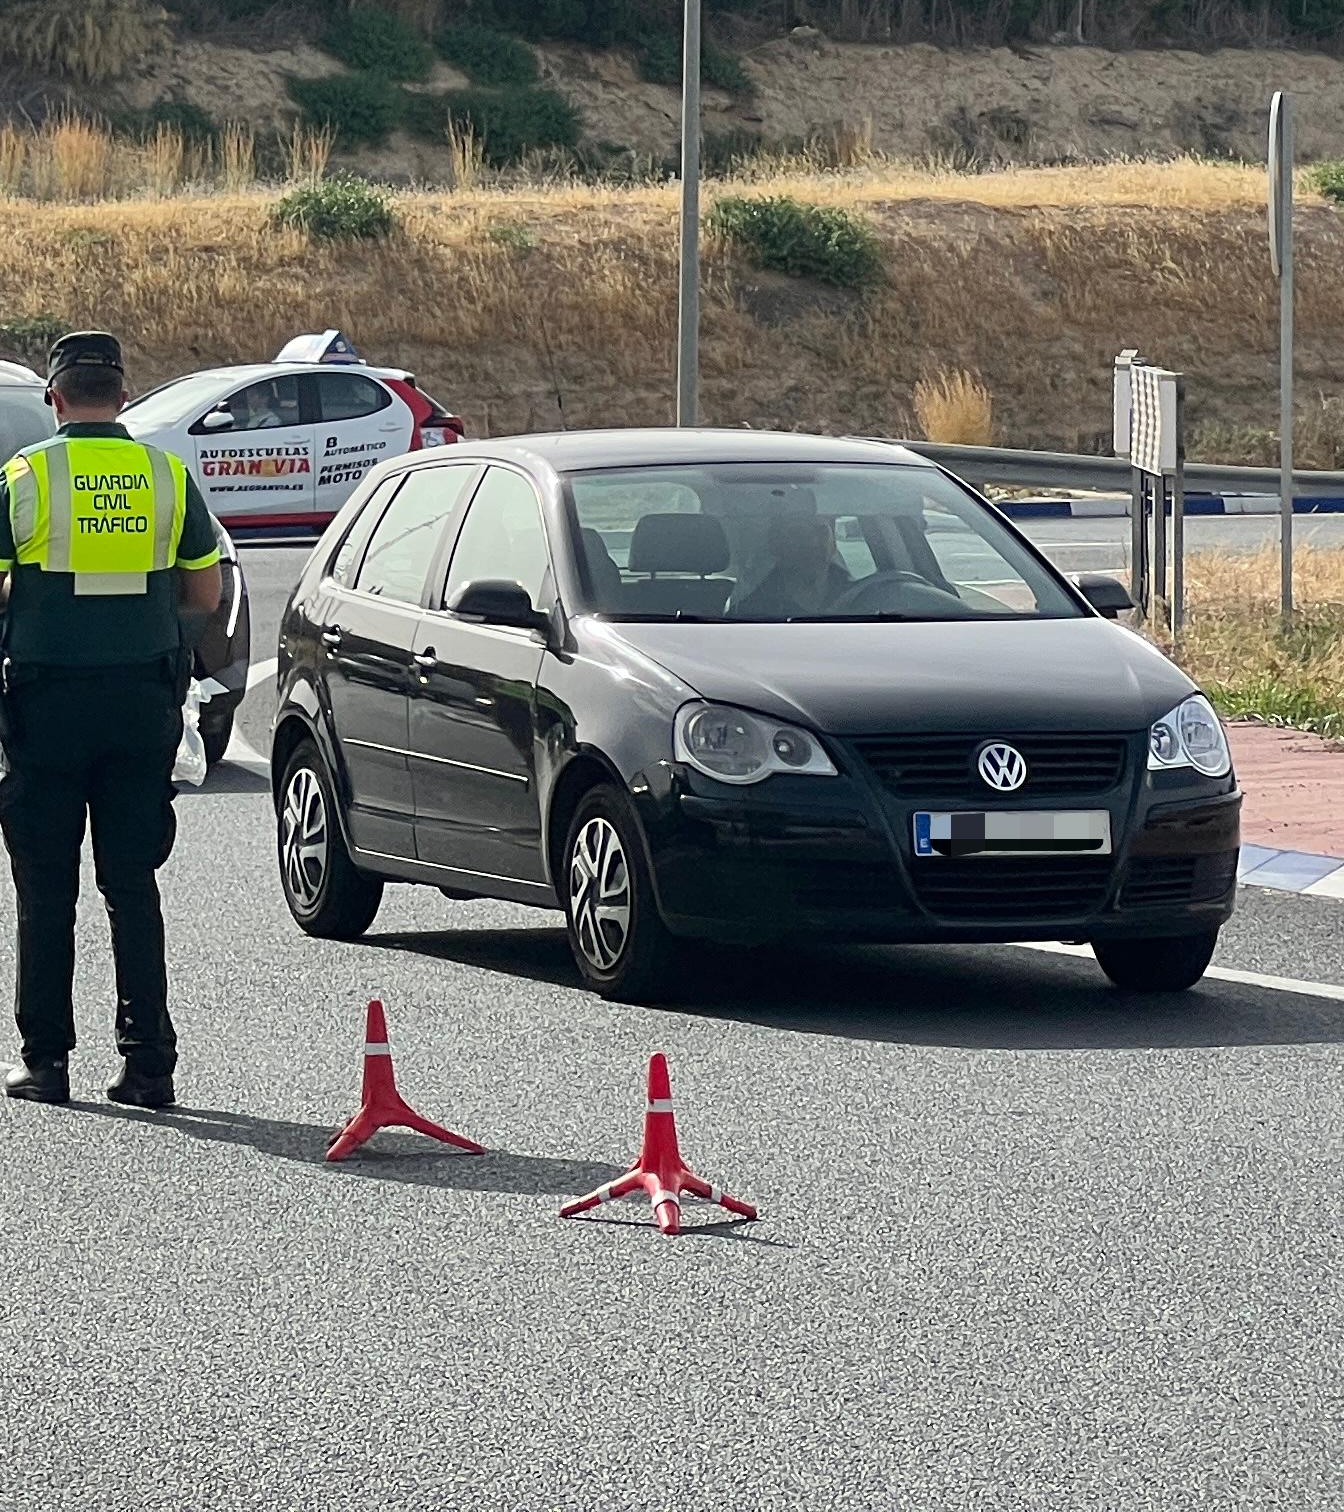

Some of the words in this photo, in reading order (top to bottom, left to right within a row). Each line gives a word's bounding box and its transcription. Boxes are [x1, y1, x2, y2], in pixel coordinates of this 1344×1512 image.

[325, 436, 338, 449] B
[199, 447, 309, 459] AUTOESCUELAS
[202, 459, 263, 477] GRAN
[319, 457, 379, 475] PERMISOS
[74, 474, 150, 491] GUARDIA
[317, 469, 363, 487] MOTO
[93, 493, 132, 510] CIVIL
[77, 513, 148, 534] TRÁFICO
